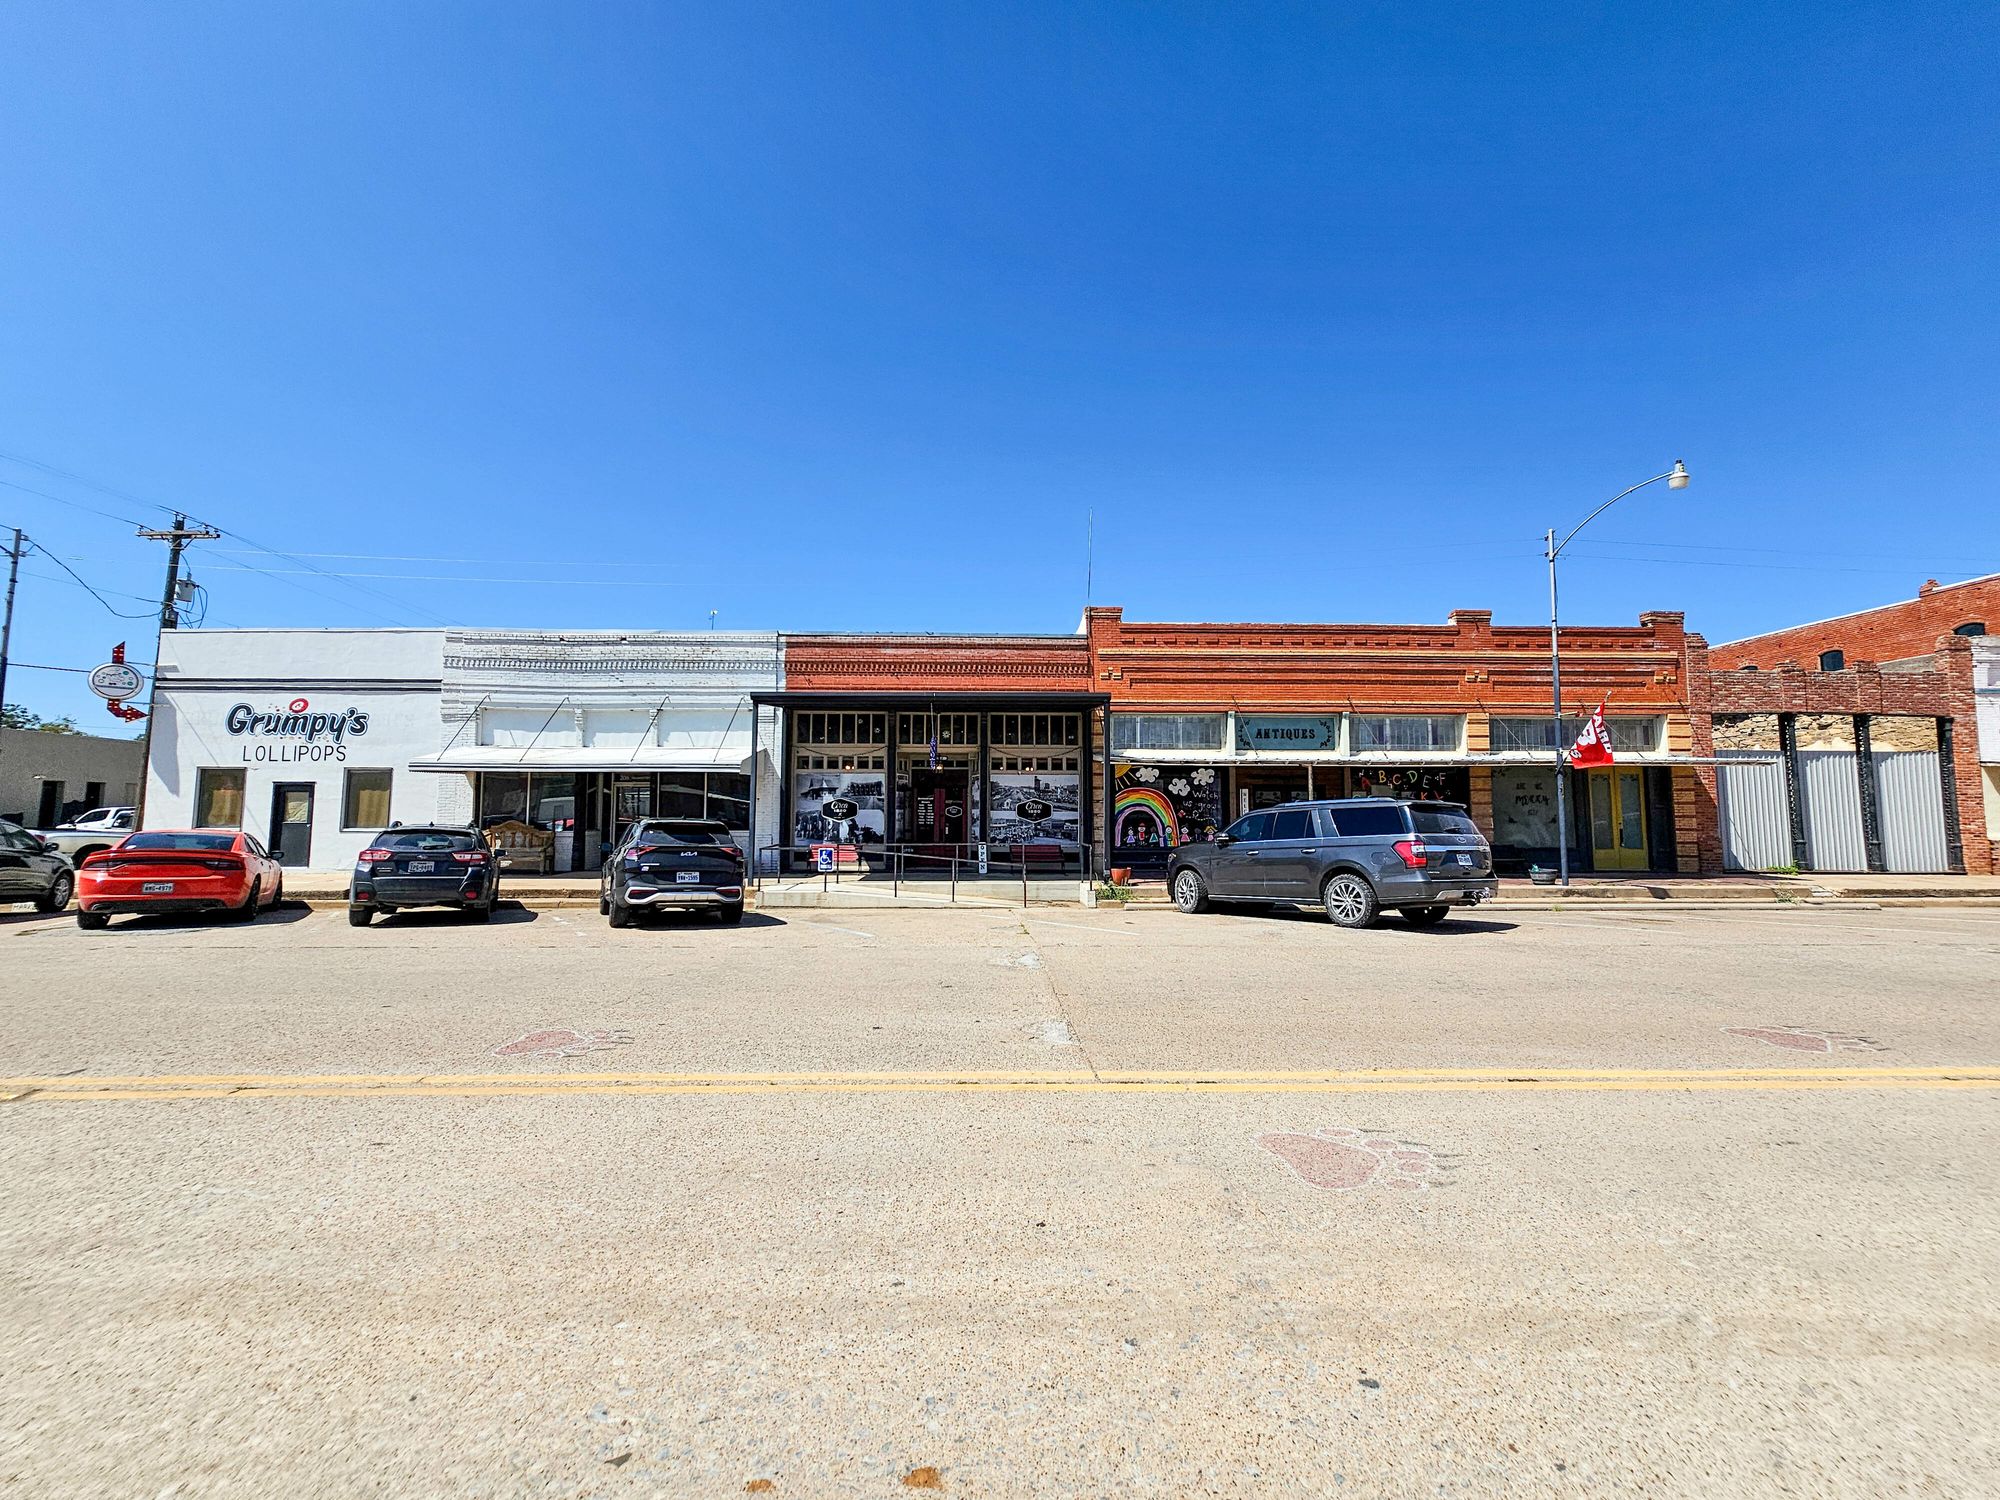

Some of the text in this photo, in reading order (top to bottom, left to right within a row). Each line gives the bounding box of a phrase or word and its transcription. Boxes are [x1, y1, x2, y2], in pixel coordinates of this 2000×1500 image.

[225, 703, 369, 744] Grumpy's
[1254, 728, 1316, 740] ANTIQUES
[242, 745, 347, 762] LOLLIPOPS
[1192, 789, 1219, 800] Watch
